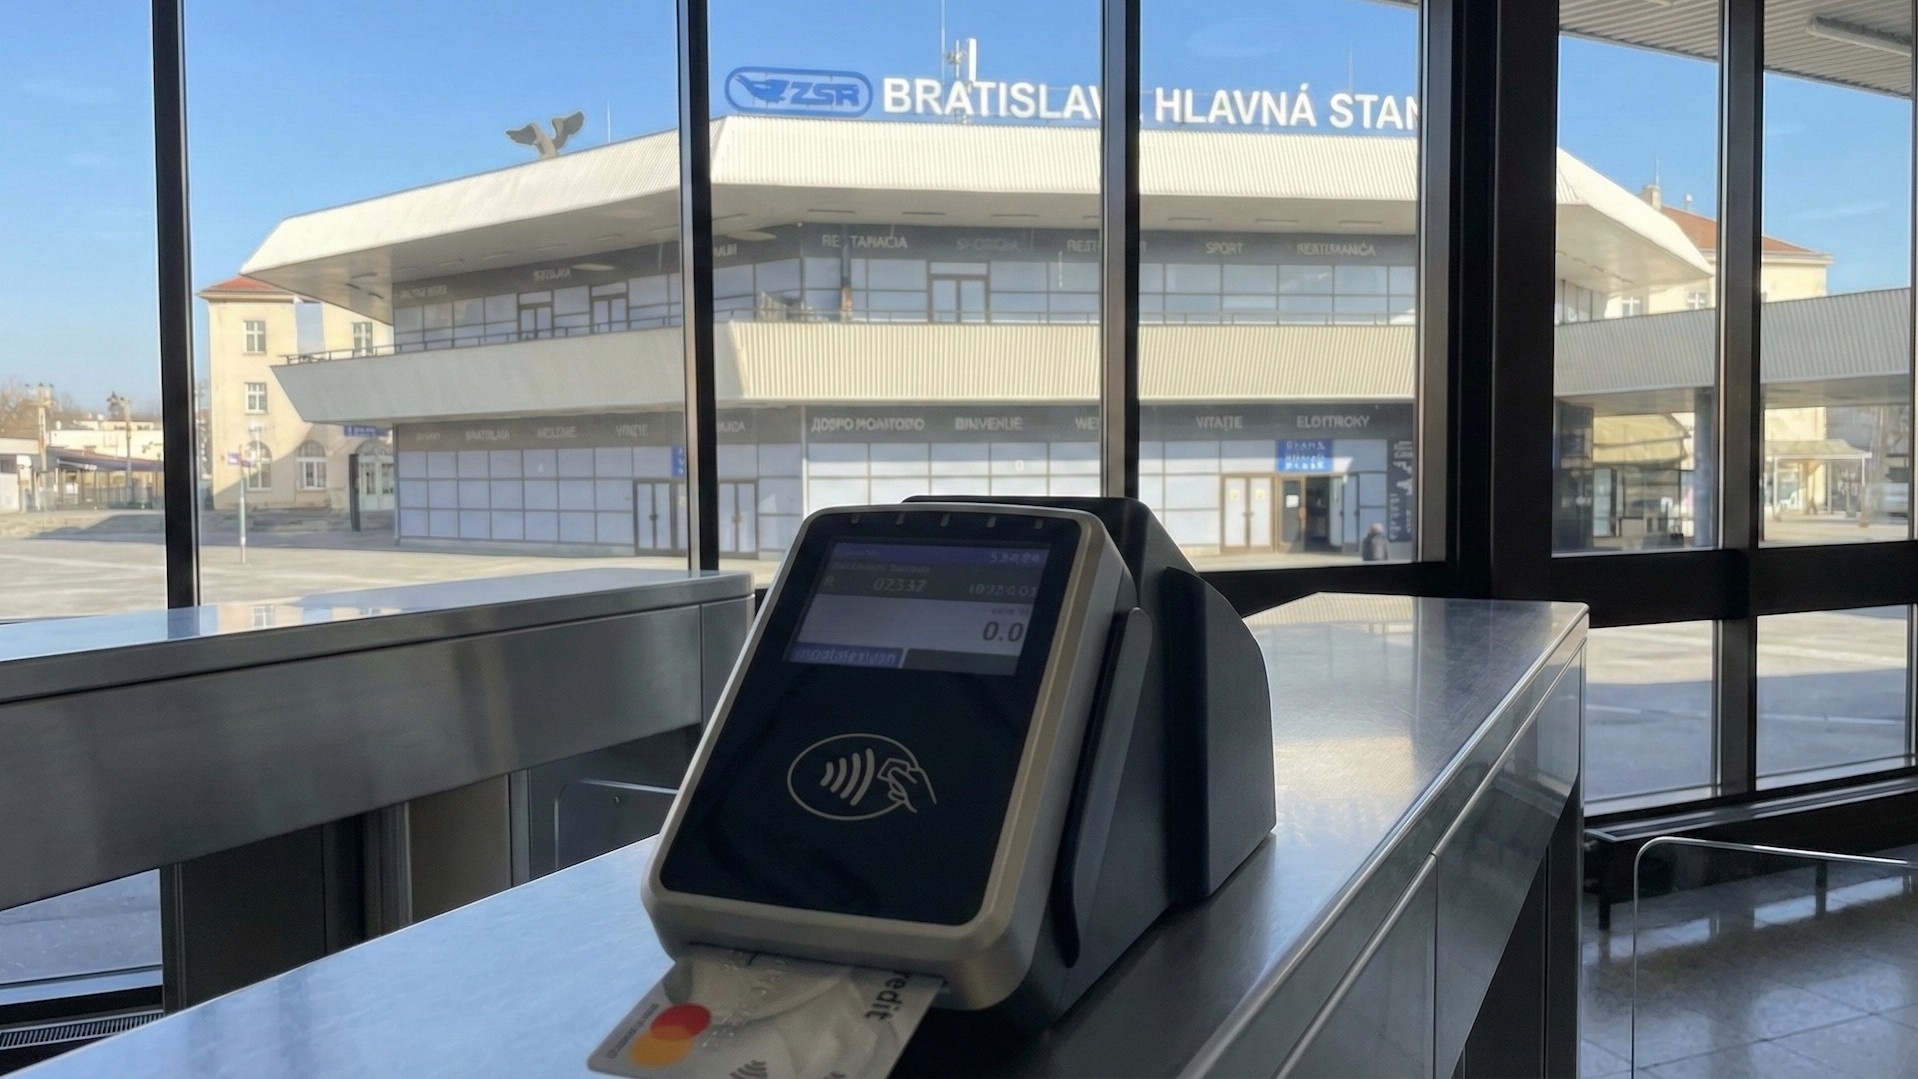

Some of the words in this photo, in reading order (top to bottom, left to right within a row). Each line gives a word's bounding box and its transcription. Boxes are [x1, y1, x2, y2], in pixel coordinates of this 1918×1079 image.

[882, 77, 1142, 121] BRATISLA
[1155, 83, 1317, 128] HLAVNÁ
[982, 621, 1024, 643] 0.0
